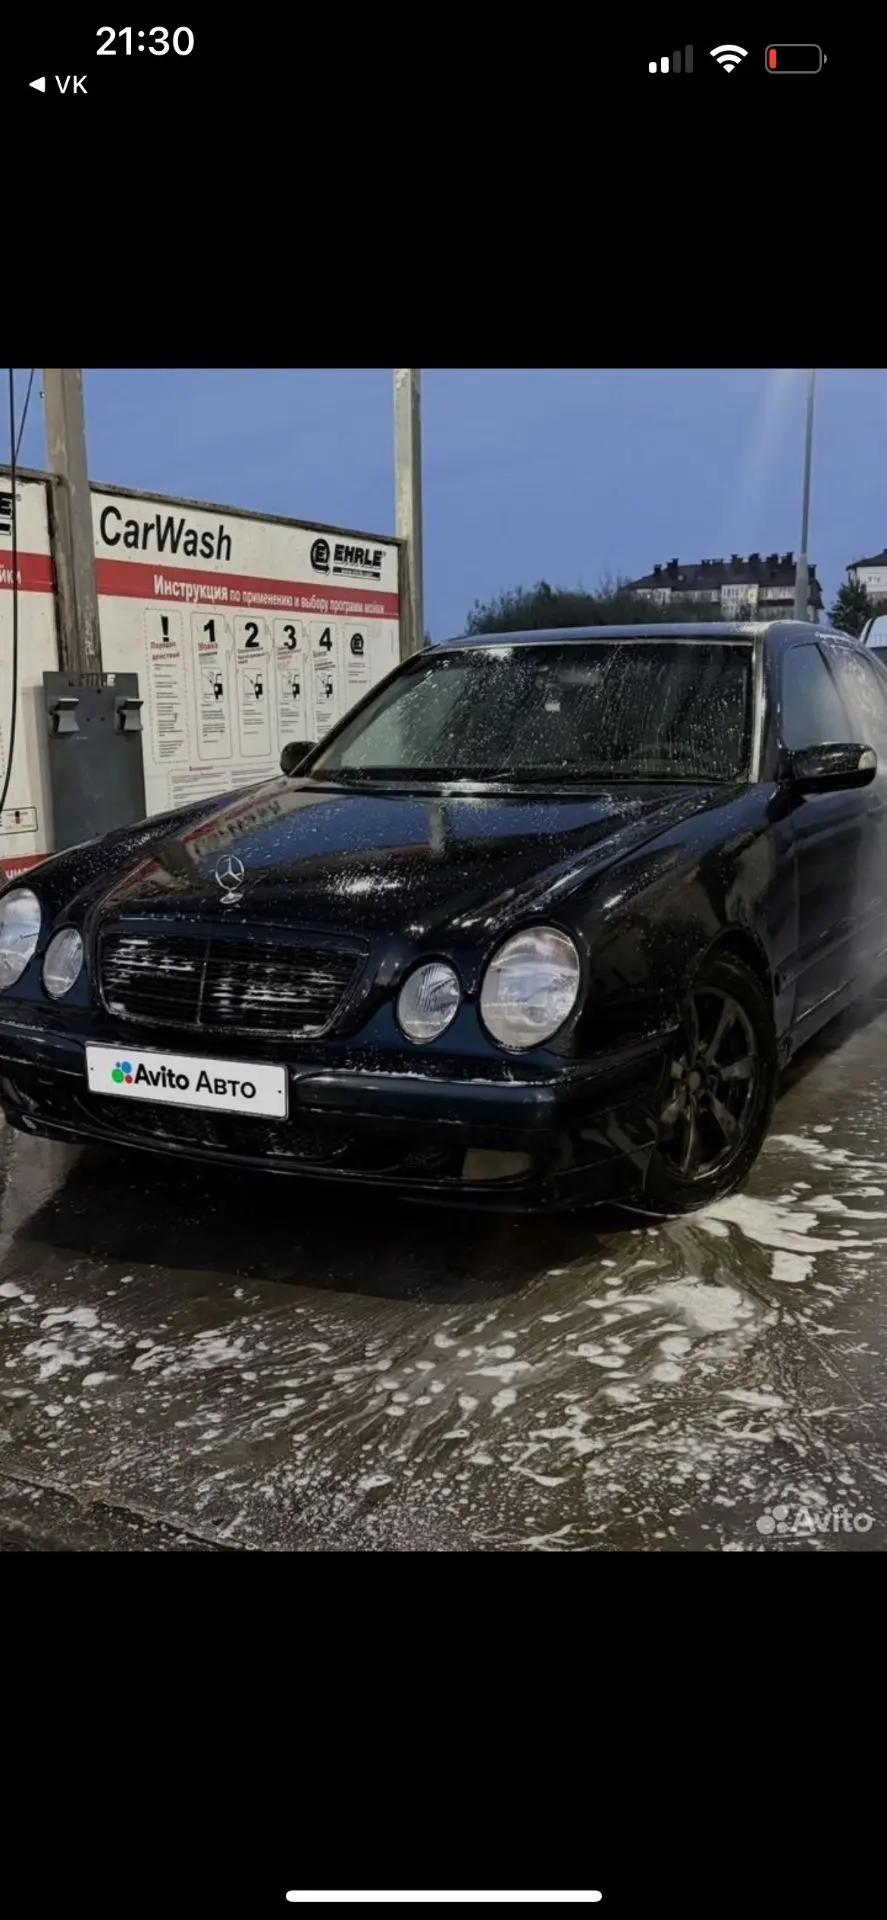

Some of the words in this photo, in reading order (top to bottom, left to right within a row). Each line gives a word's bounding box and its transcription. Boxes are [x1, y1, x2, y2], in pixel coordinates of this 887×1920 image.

[100, 505, 232, 561] CarWash
[334, 544, 382, 567] EHRLE
[153, 574, 228, 603] Инструкция
[229, 589, 240, 602] по
[242, 590, 293, 607] применению
[294, 596, 300, 608] и
[301, 594, 328, 613] выбору
[203, 619, 216, 642] 1
[244, 622, 260, 648] 2
[283, 624, 297, 650] 3
[318, 627, 333, 652] 4
